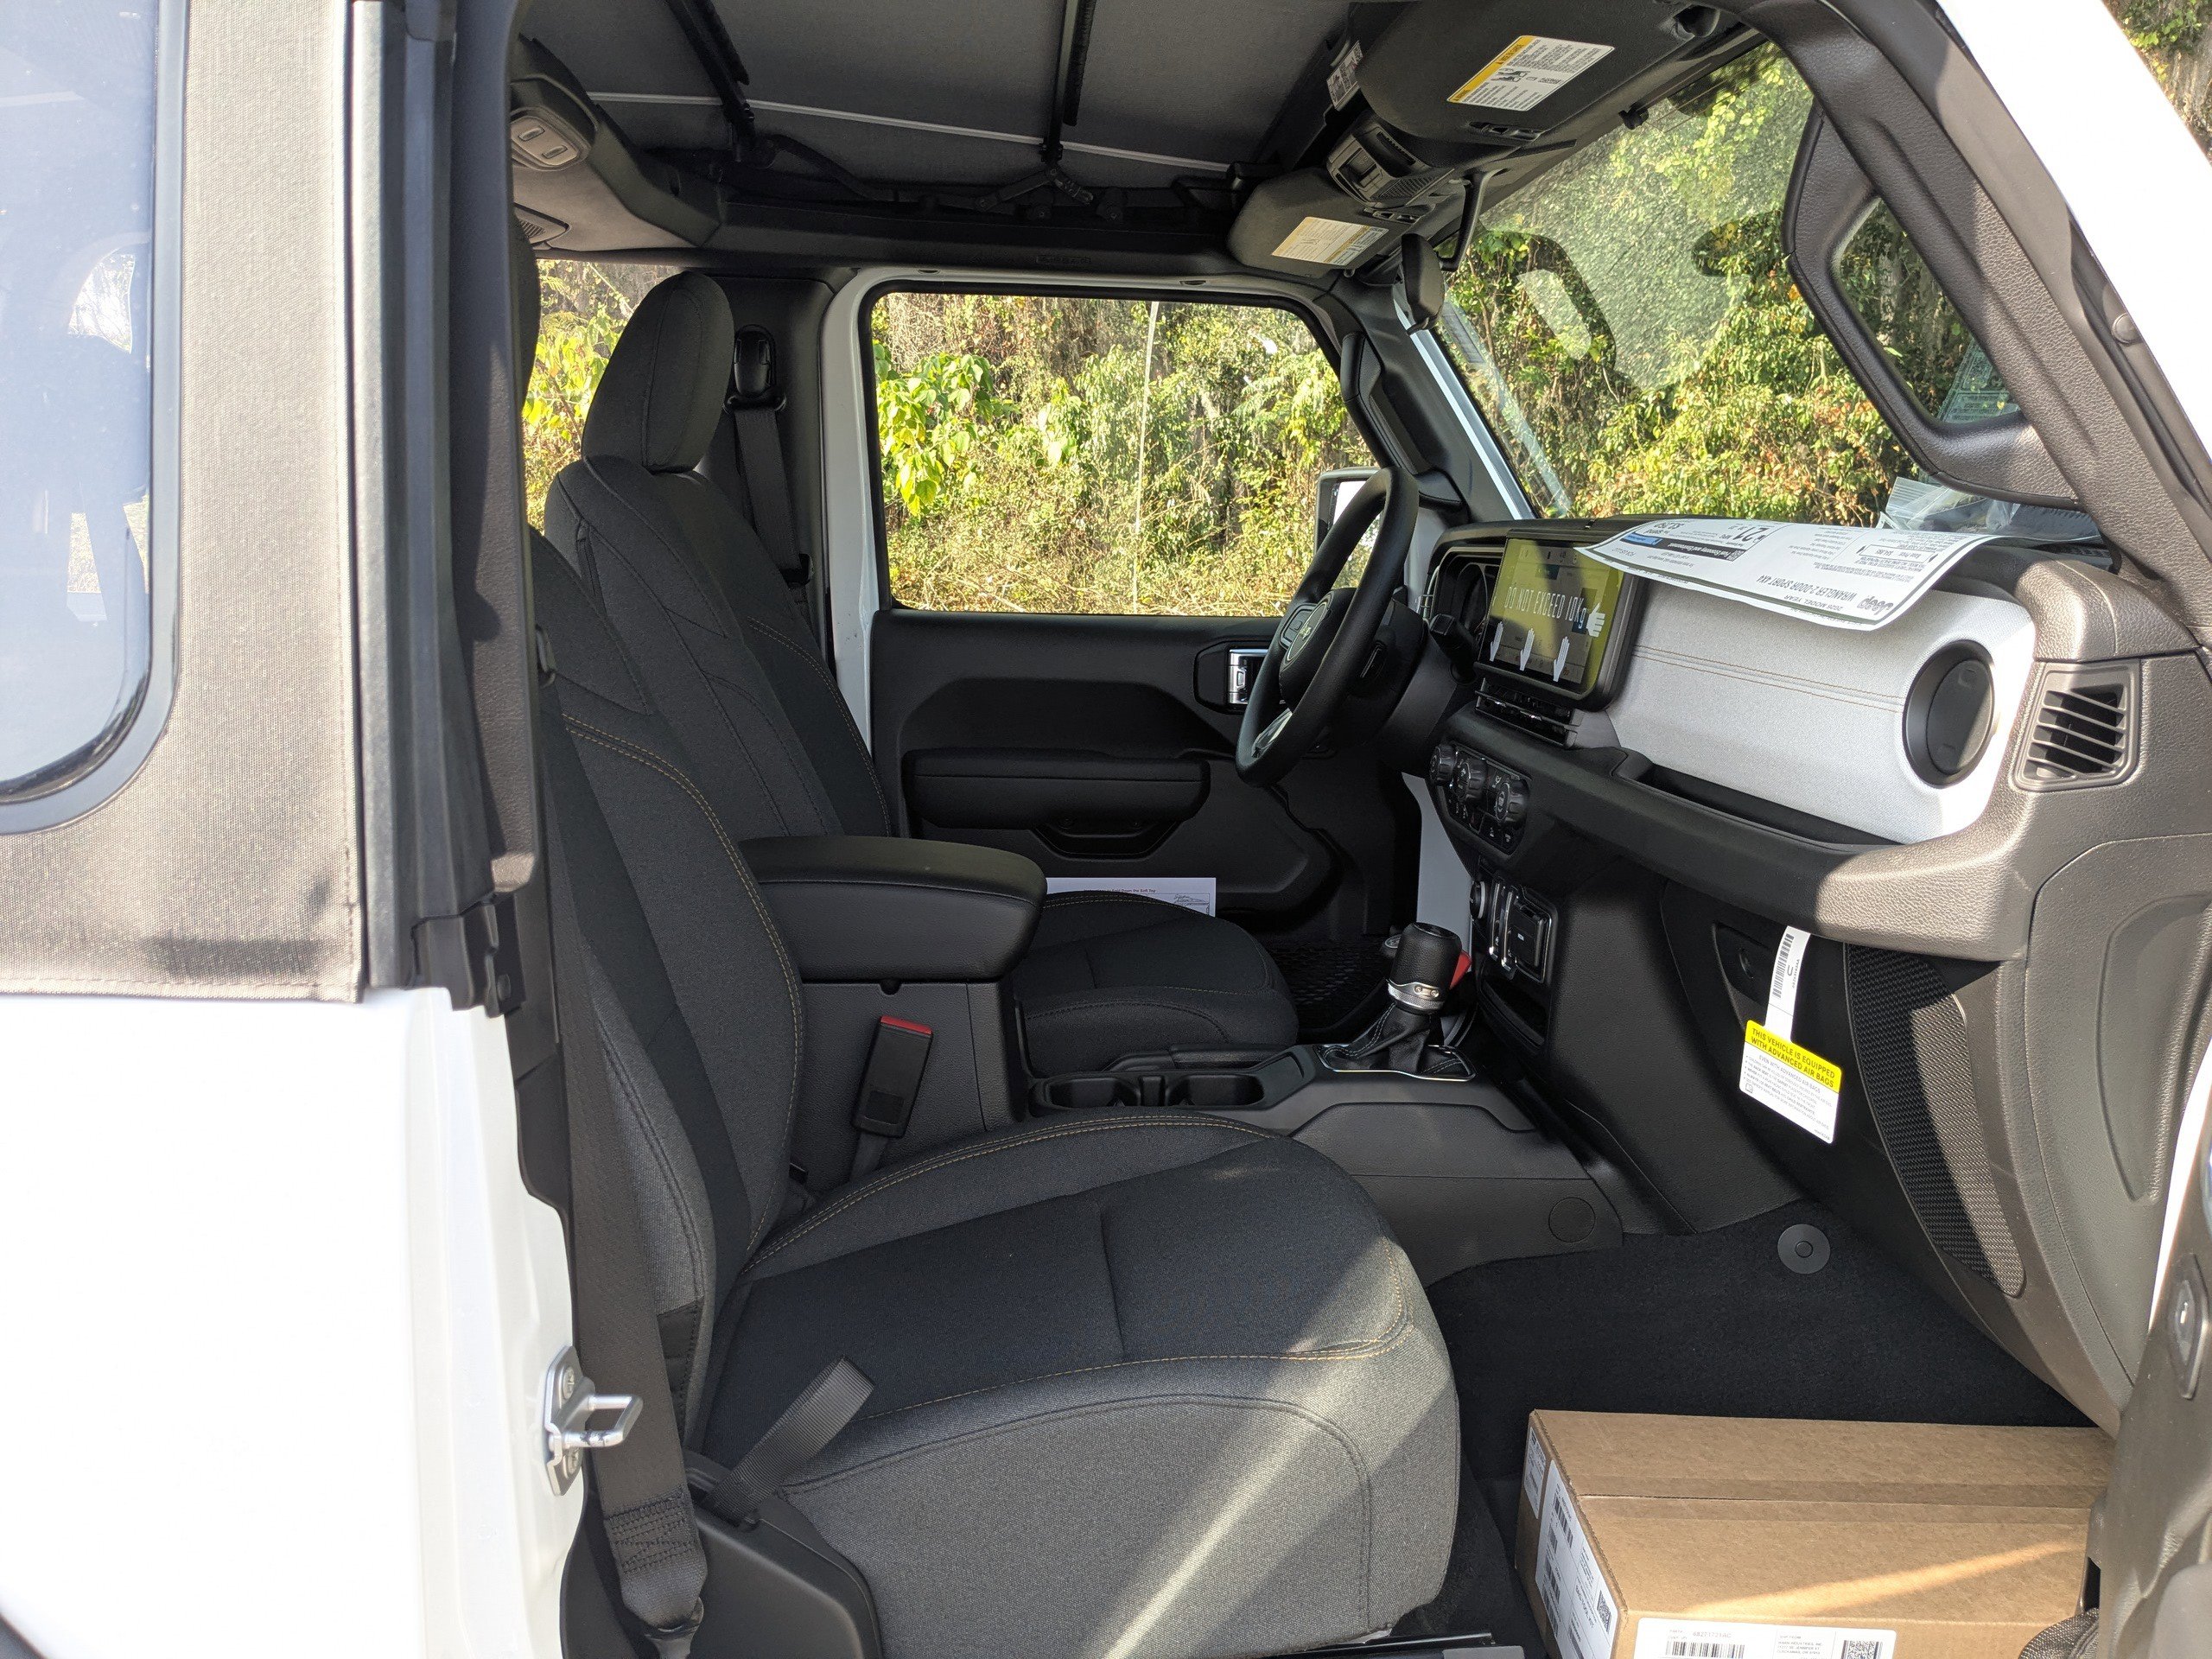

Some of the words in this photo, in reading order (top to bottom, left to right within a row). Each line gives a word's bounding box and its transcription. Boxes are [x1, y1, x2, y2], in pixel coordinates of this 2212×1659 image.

[1733, 526, 1770, 543] 21
[1756, 574, 1771, 584] 4X4
[1770, 577, 1790, 588] SPORT
[1789, 582, 1816, 594] 2-DOOR
[1815, 589, 1858, 601] WRANGLER
[1783, 594, 1802, 603] YEAR
[1804, 599, 1827, 608] MODEL
[1858, 594, 1894, 615] Jeep
[1503, 587, 1517, 609] DO
[1516, 588, 1535, 612] NOT
[1533, 591, 1566, 619] EXCEED
[1565, 596, 1587, 629] 10Kg
[1752, 1028, 1767, 1040] THIS
[1767, 1036, 1794, 1055] VEHICLE
[1795, 1051, 1801, 1060] IS
[1802, 1055, 1835, 1079] EQUIPPED
[1751, 1037, 1767, 1051] WITH
[1768, 1046, 1802, 1070] ADVANCED
[1803, 1066, 1815, 1077] AIR
[1815, 1073, 1834, 1088] BAGS
[1759, 1055, 1770, 1065] EVEN
[1770, 1061, 1780, 1070] WITH
[1780, 1066, 1802, 1083] ADVANCED
[1809, 1083, 1821, 1094] BAGS
